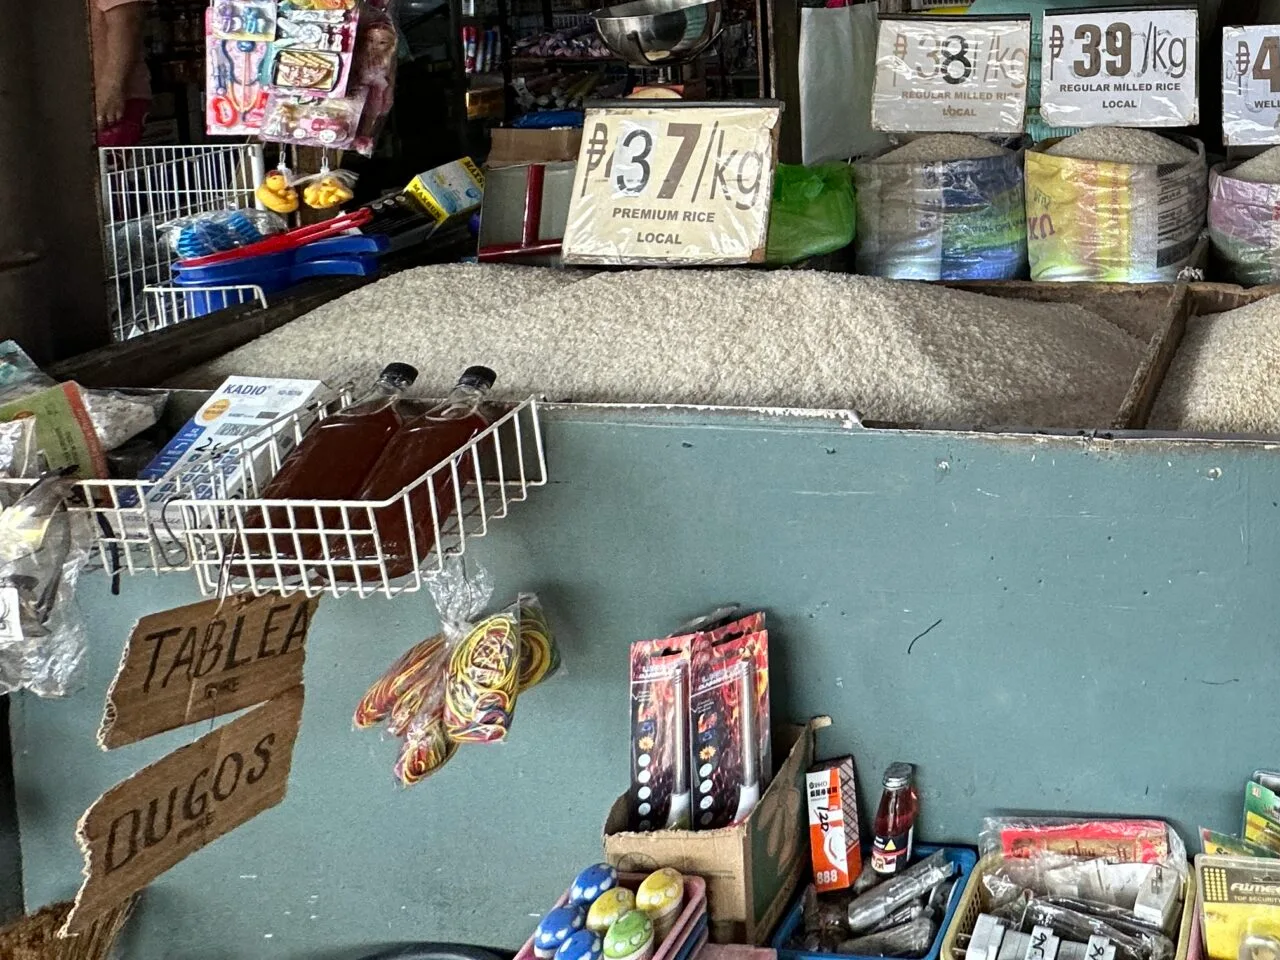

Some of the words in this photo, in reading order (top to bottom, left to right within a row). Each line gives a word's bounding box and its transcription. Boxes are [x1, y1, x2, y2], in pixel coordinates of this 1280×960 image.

[1059, 83, 1111, 93] REGULAR
[1113, 83, 1152, 92] MILLED
[1155, 83, 1181, 91] RICE
[902, 90, 950, 100] REGULAR
[954, 90, 993, 100] MILLED
[1102, 100, 1138, 109] LOCAL
[942, 107, 977, 117] LOCAL
[612, 207, 678, 222] PREMIUM
[682, 210, 715, 223] RICE
[636, 231, 682, 245] LOCAL
[222, 384, 267, 395] KADIO
[142, 600, 310, 693] TABLEA
[104, 733, 275, 875] DUGOS
[816, 870, 838, 884] 888
